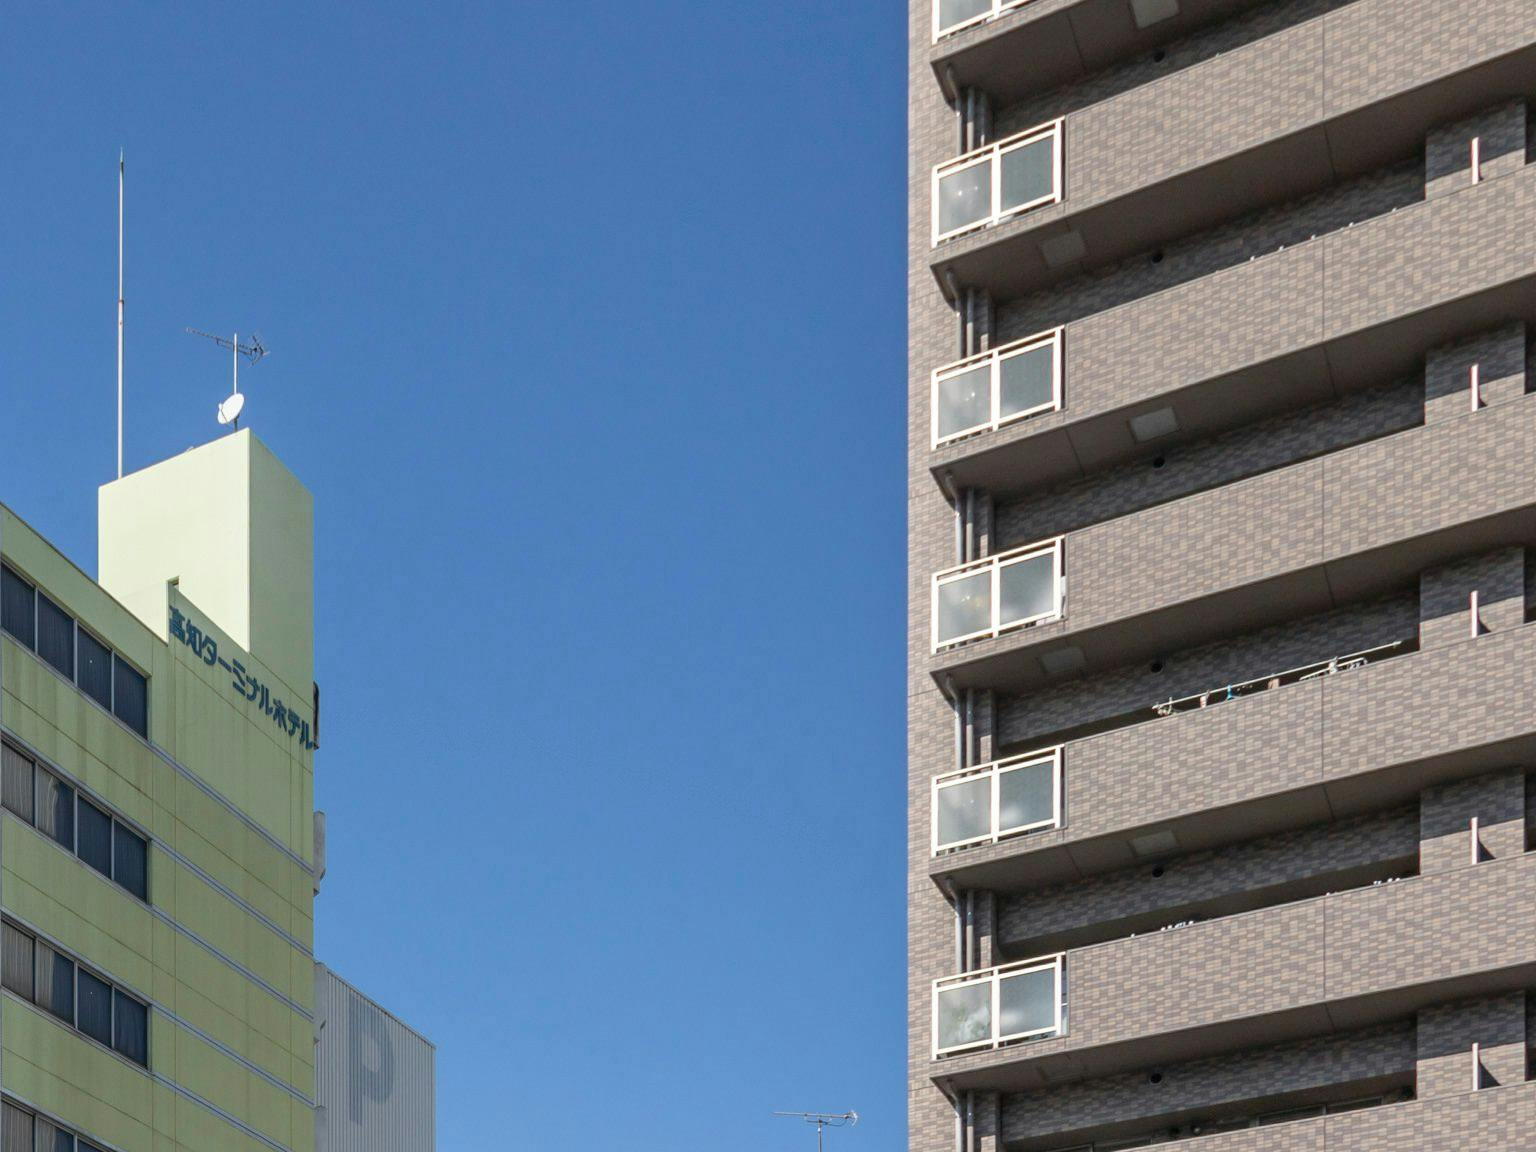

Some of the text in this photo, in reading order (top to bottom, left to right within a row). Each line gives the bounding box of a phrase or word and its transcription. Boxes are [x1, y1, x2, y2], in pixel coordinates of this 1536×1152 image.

[169, 604, 313, 749] 高知ターミナルホテル
[348, 990, 394, 1127] P
